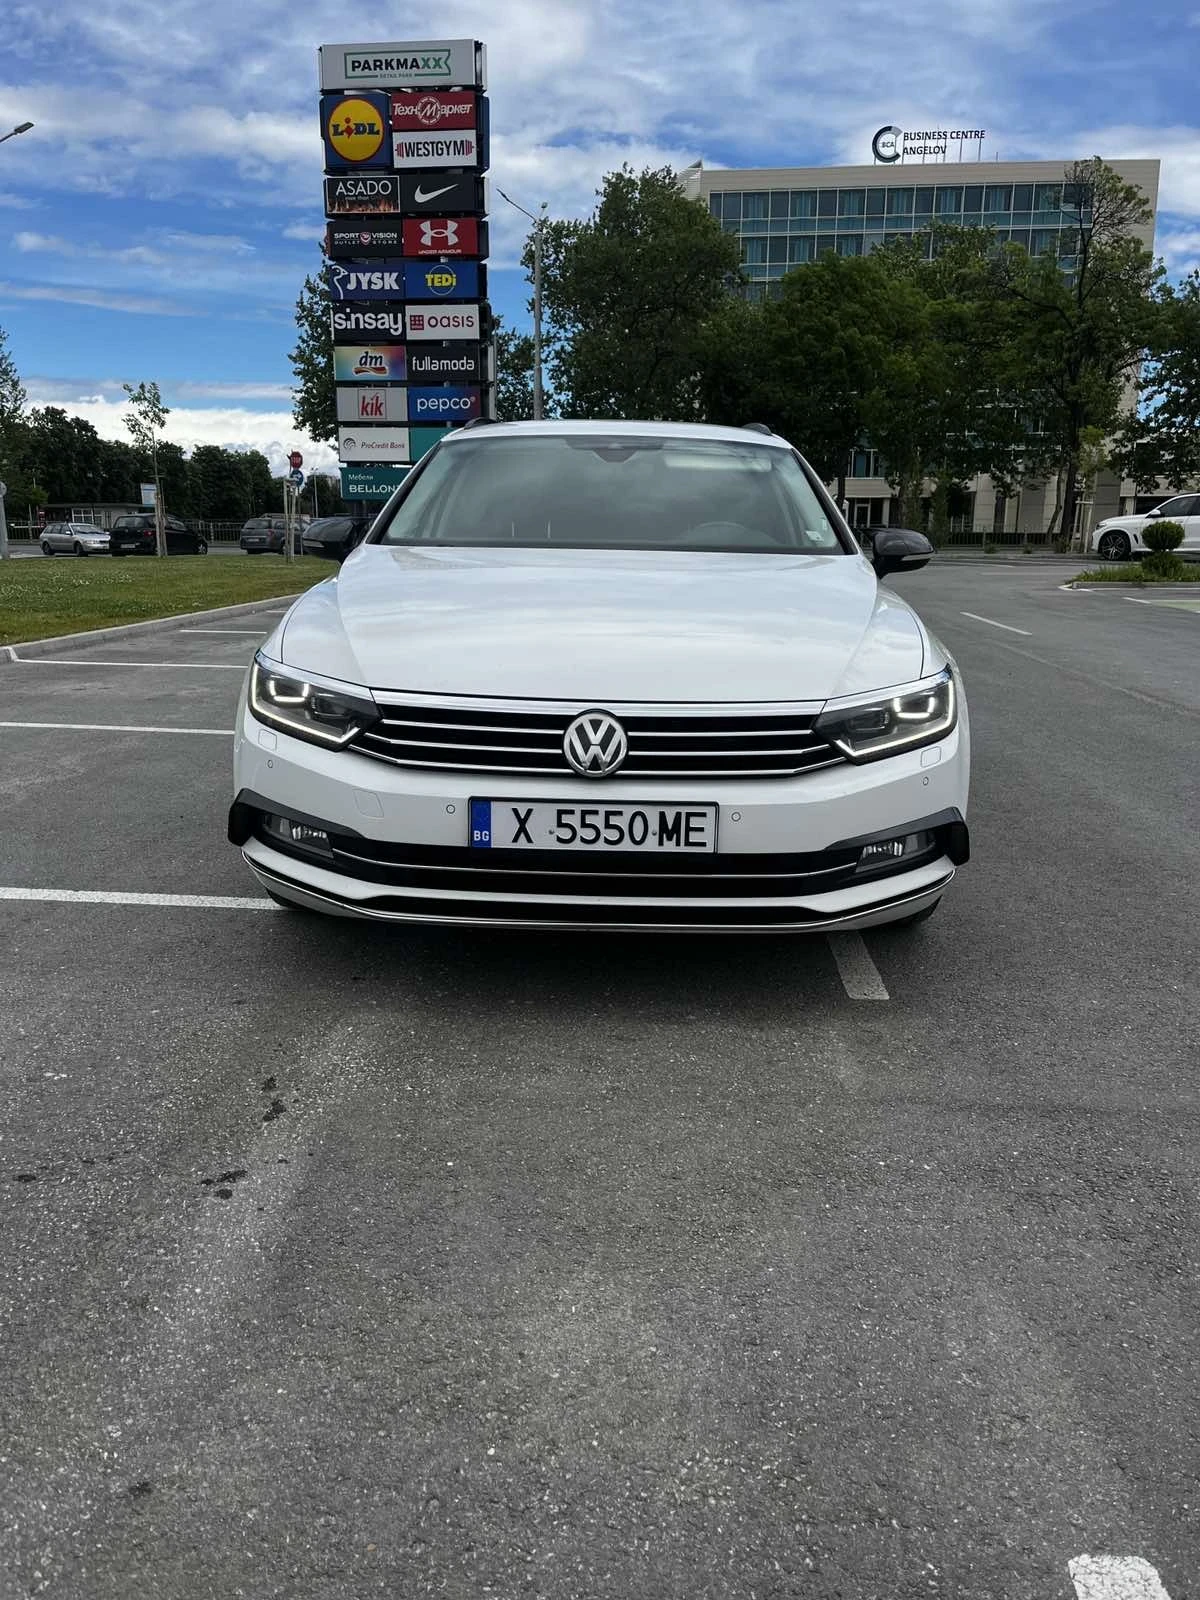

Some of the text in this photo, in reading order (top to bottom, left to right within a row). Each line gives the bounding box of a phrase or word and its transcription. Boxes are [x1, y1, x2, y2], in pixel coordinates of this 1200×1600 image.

[351, 57, 443, 72] PARKMAXX
[903, 130, 985, 140] BUSINESS CENTRE
[404, 140, 465, 157] WESTGYM
[903, 145, 947, 155] ANGELOV
[336, 180, 392, 196] ASADO
[346, 272, 400, 290] JYSK
[334, 308, 402, 336] sinsay
[427, 315, 475, 328] oasis
[359, 351, 383, 367] dm
[412, 356, 475, 371] fullamoda
[417, 398, 471, 412] pepco
[361, 441, 389, 449] ProCredit
[349, 484, 400, 493] BELLON
[511, 808, 707, 847] X 5550 ME
[473, 830, 490, 842] BG
